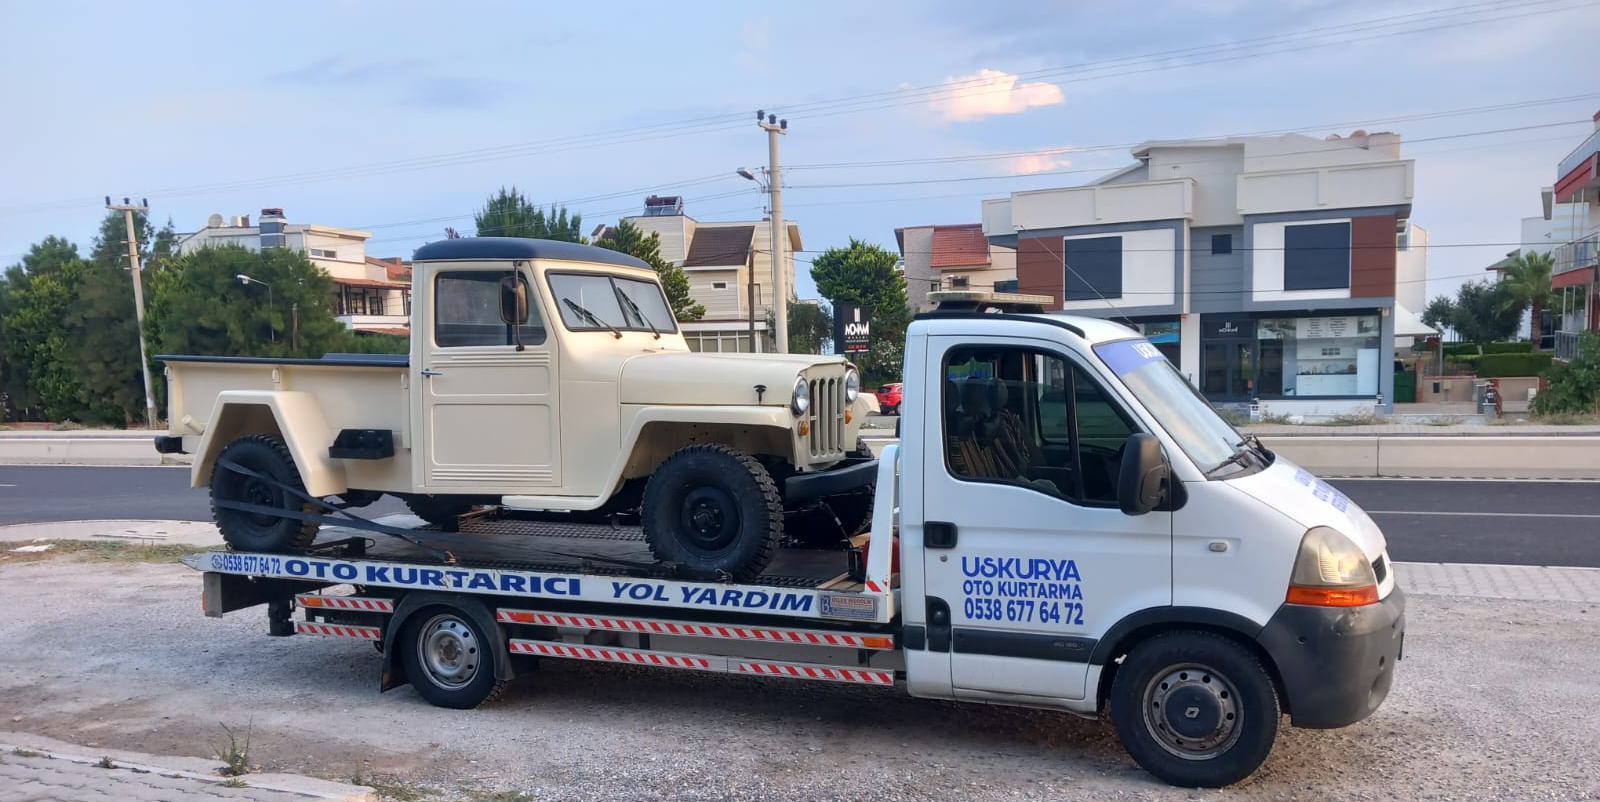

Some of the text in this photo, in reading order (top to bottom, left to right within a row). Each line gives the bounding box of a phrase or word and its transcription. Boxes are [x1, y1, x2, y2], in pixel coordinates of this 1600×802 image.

[223, 554, 281, 575] 0538 677 64 72
[285, 559, 581, 596] OTO KURTARICI
[962, 556, 1081, 581] USKURYA
[612, 581, 670, 602] YOL
[681, 586, 814, 612] YARDIM
[963, 580, 1083, 600] OTO KURTARMA
[964, 598, 1084, 625] 0538 677 64 72
